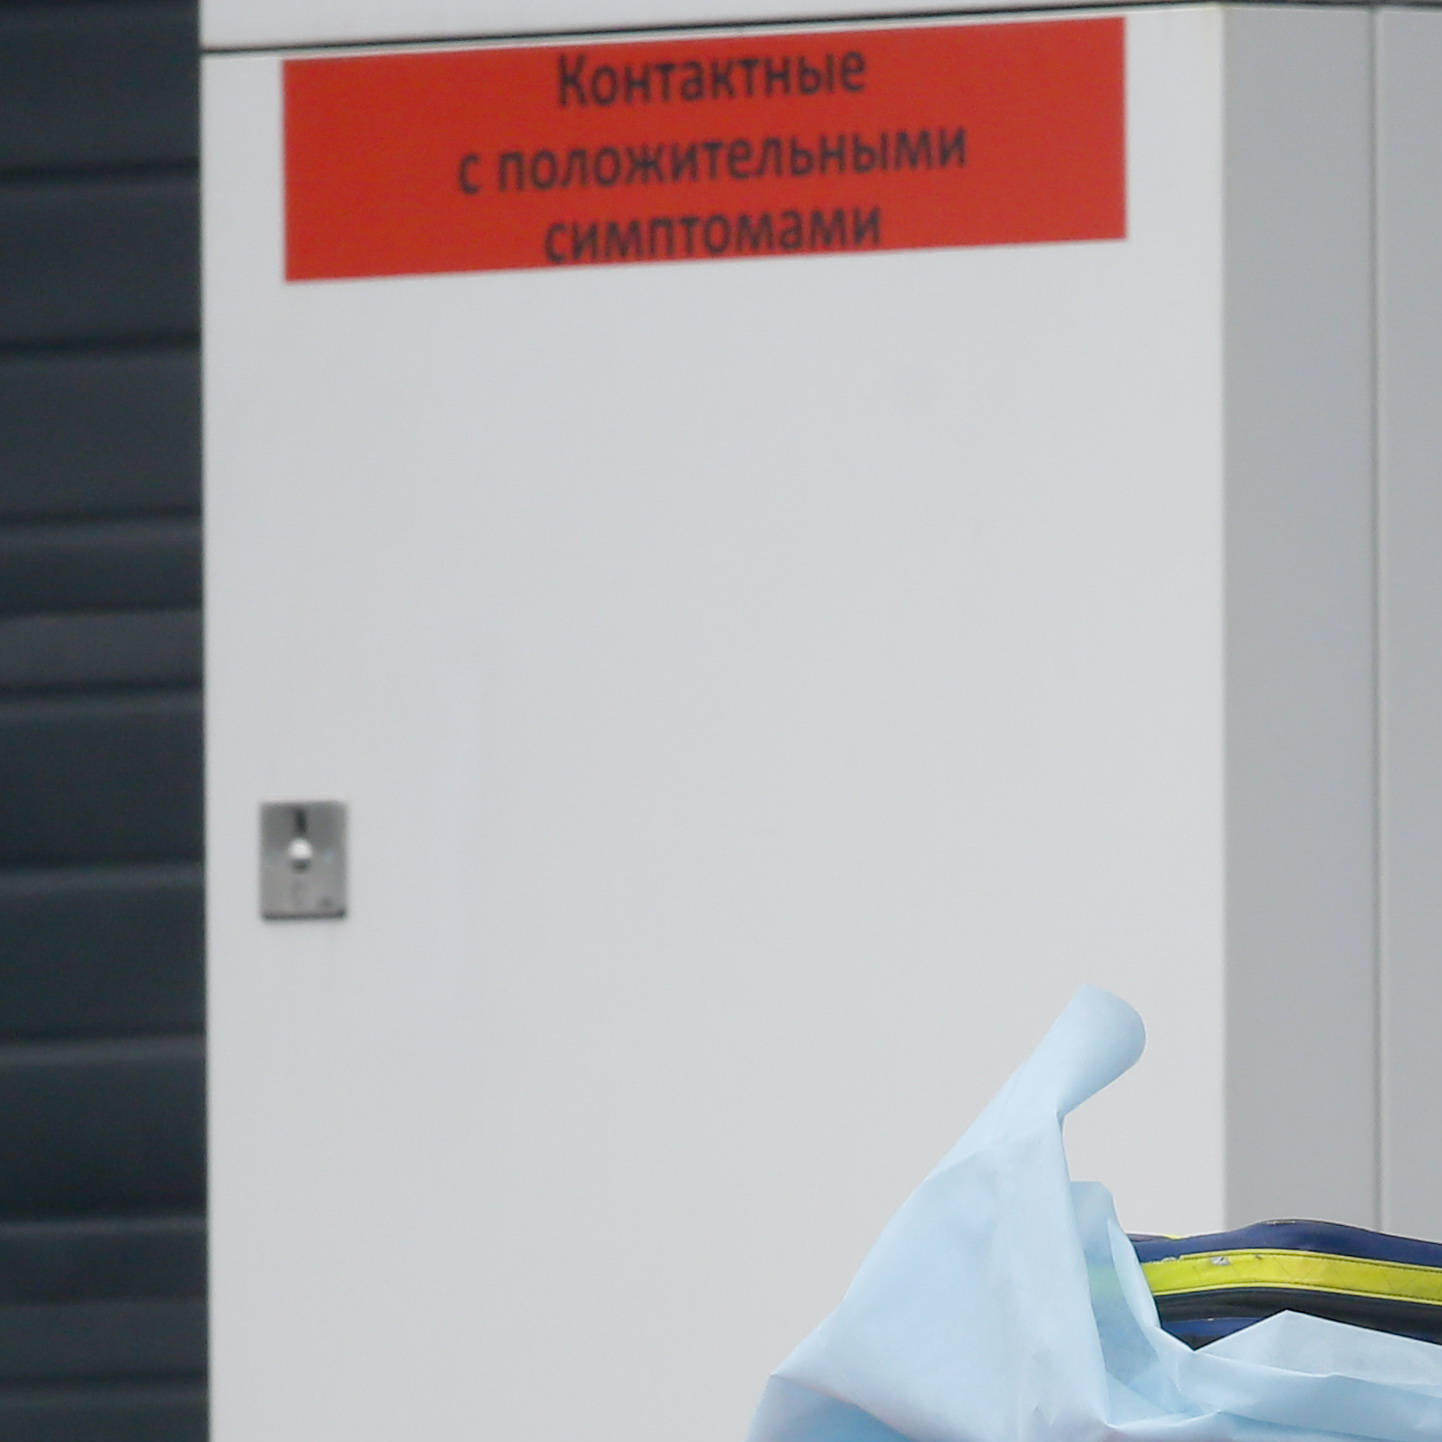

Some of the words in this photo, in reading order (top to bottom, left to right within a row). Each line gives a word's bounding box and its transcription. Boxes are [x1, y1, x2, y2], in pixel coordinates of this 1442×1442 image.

[557, 50, 867, 108] Контактные
[458, 153, 483, 196] с
[497, 126, 968, 192] положительными
[544, 207, 883, 264] симптомами
